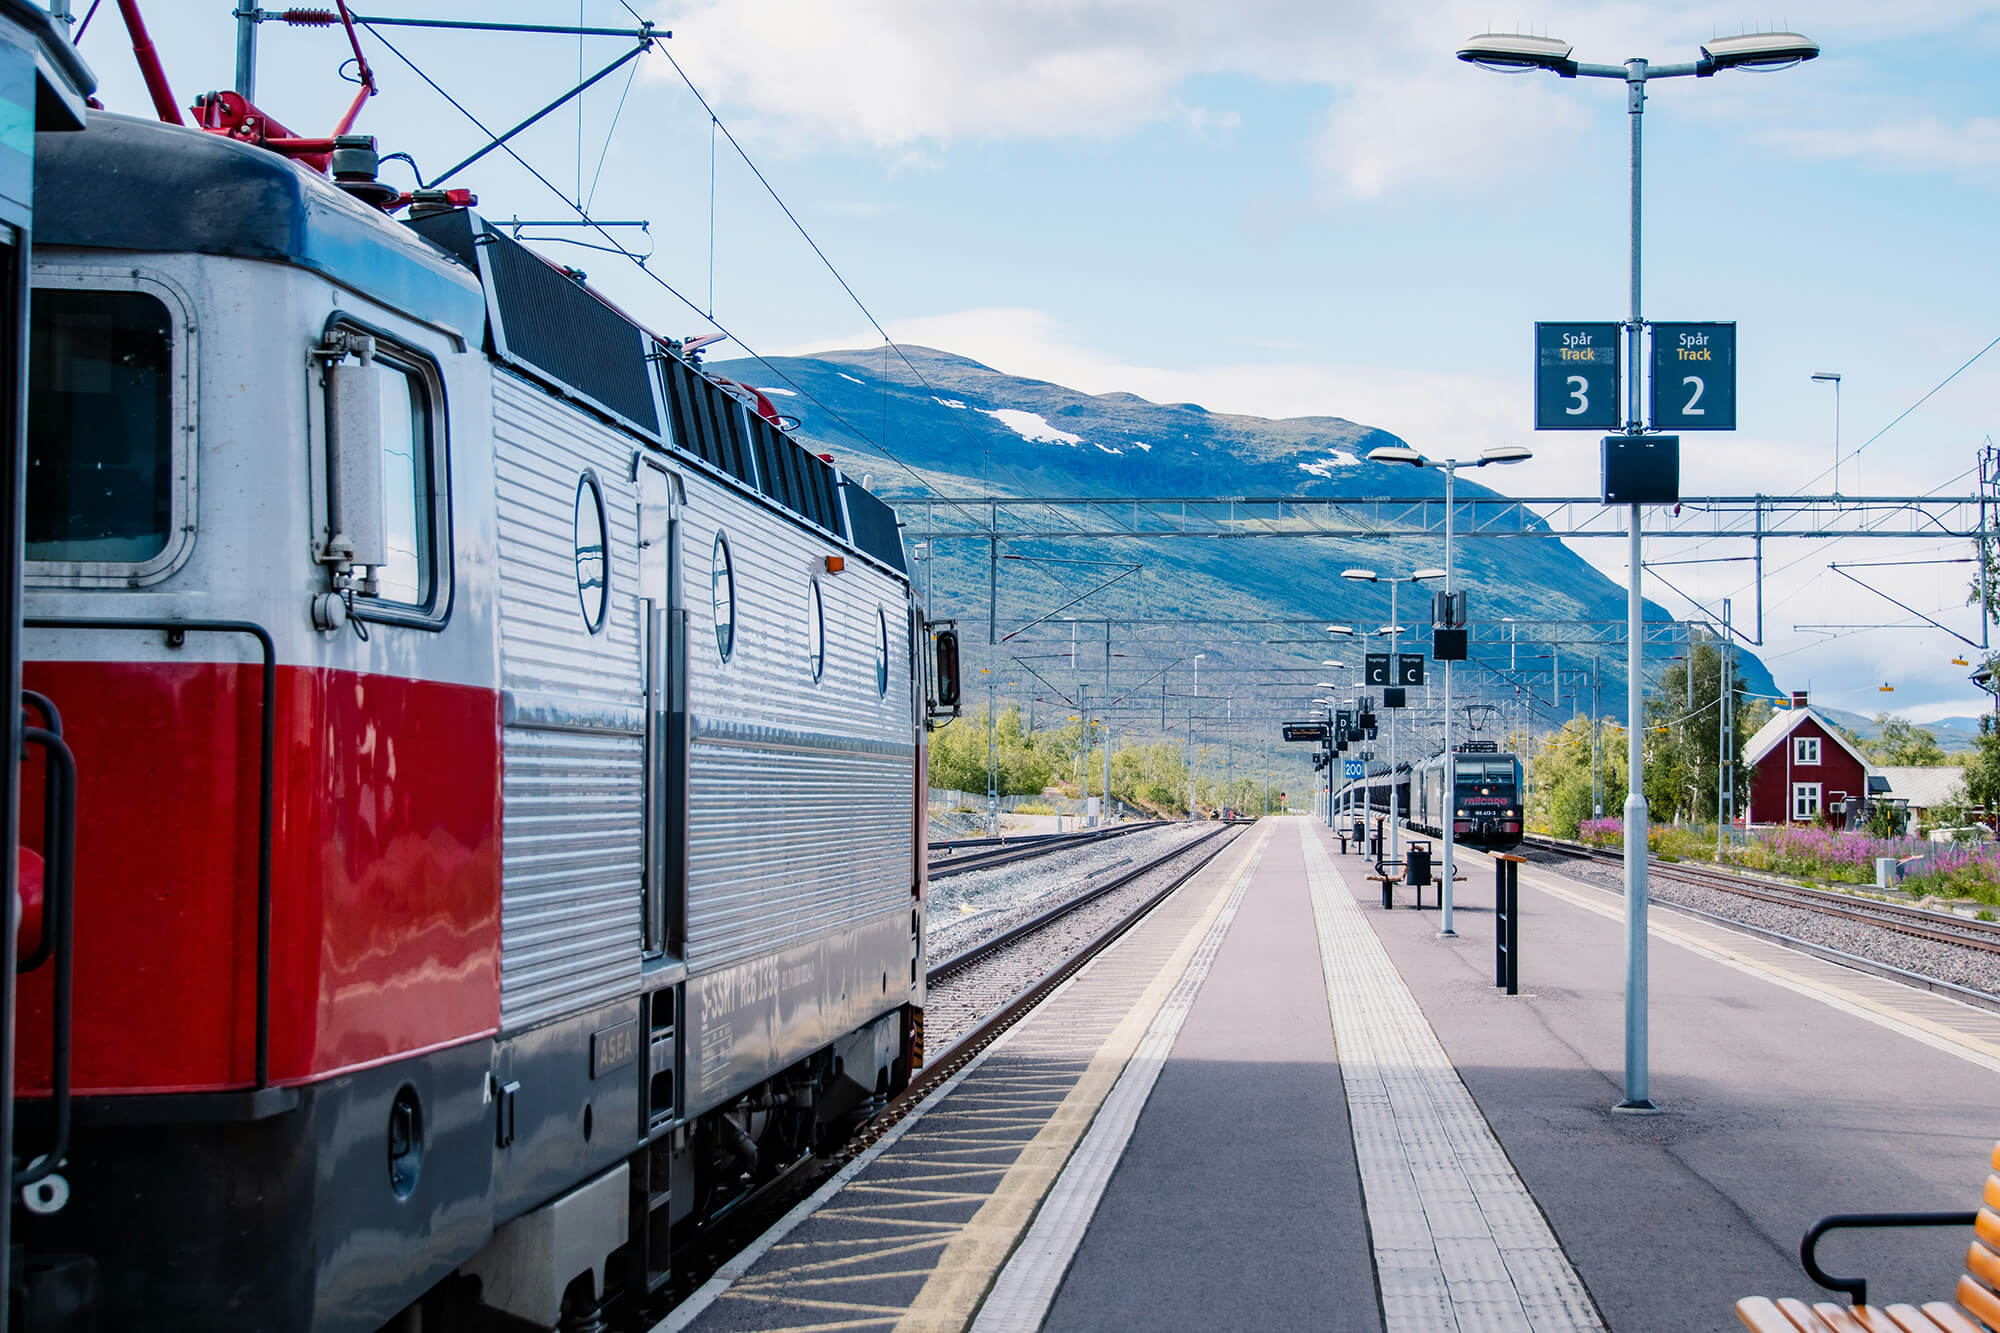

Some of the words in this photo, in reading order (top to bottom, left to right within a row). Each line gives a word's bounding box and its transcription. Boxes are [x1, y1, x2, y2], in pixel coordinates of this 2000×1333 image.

[1562, 332, 1593, 348] Spår
[1679, 332, 1709, 348] Spår
[1560, 348, 1595, 361] Track
[1676, 348, 1711, 361] Track
[1565, 375, 1589, 415] 3
[1681, 375, 1705, 415] 2
[1373, 669, 1382, 682] C
[1407, 669, 1416, 682] C
[1340, 719, 1347, 727] D
[1345, 763, 1362, 776] 200
[702, 967, 737, 1023] S-SSRT
[740, 962, 757, 1009] Rc6
[600, 1029, 633, 1068] ASEA
